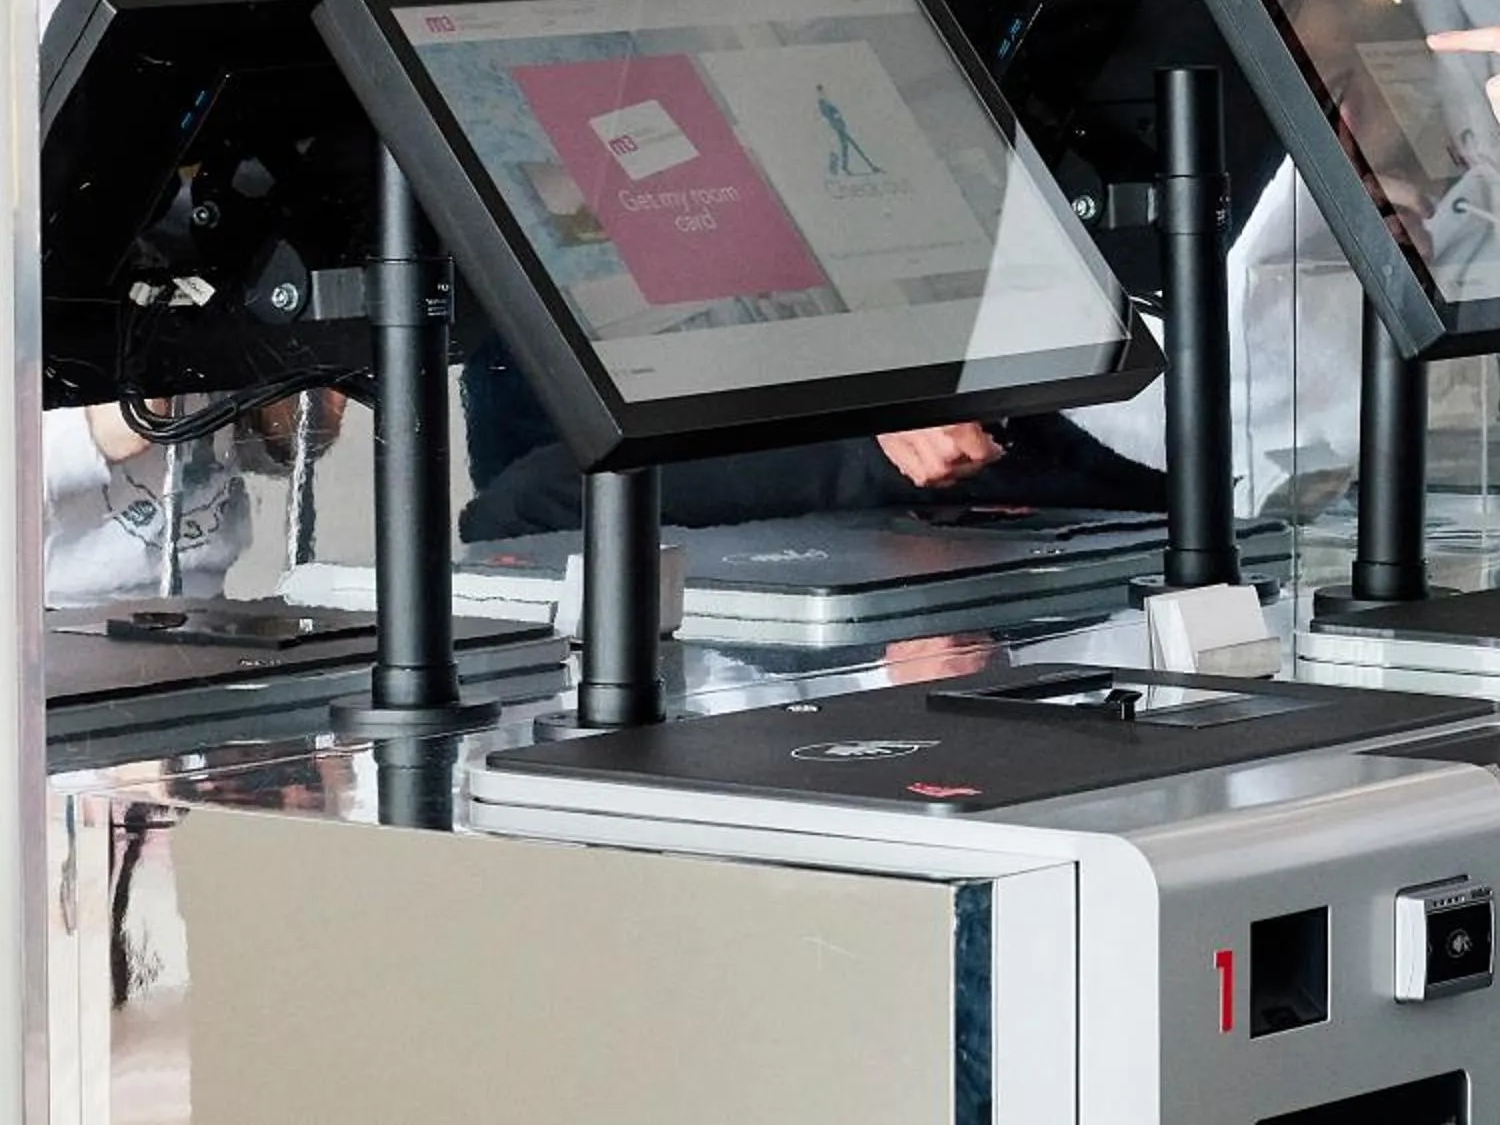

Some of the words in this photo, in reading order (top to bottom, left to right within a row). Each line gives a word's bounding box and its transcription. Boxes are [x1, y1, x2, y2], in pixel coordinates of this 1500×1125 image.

[618, 188, 659, 212] Get
[659, 191, 690, 214] my
[690, 185, 740, 205] room
[675, 206, 717, 233] card
[1214, 949, 1234, 1034] 1
